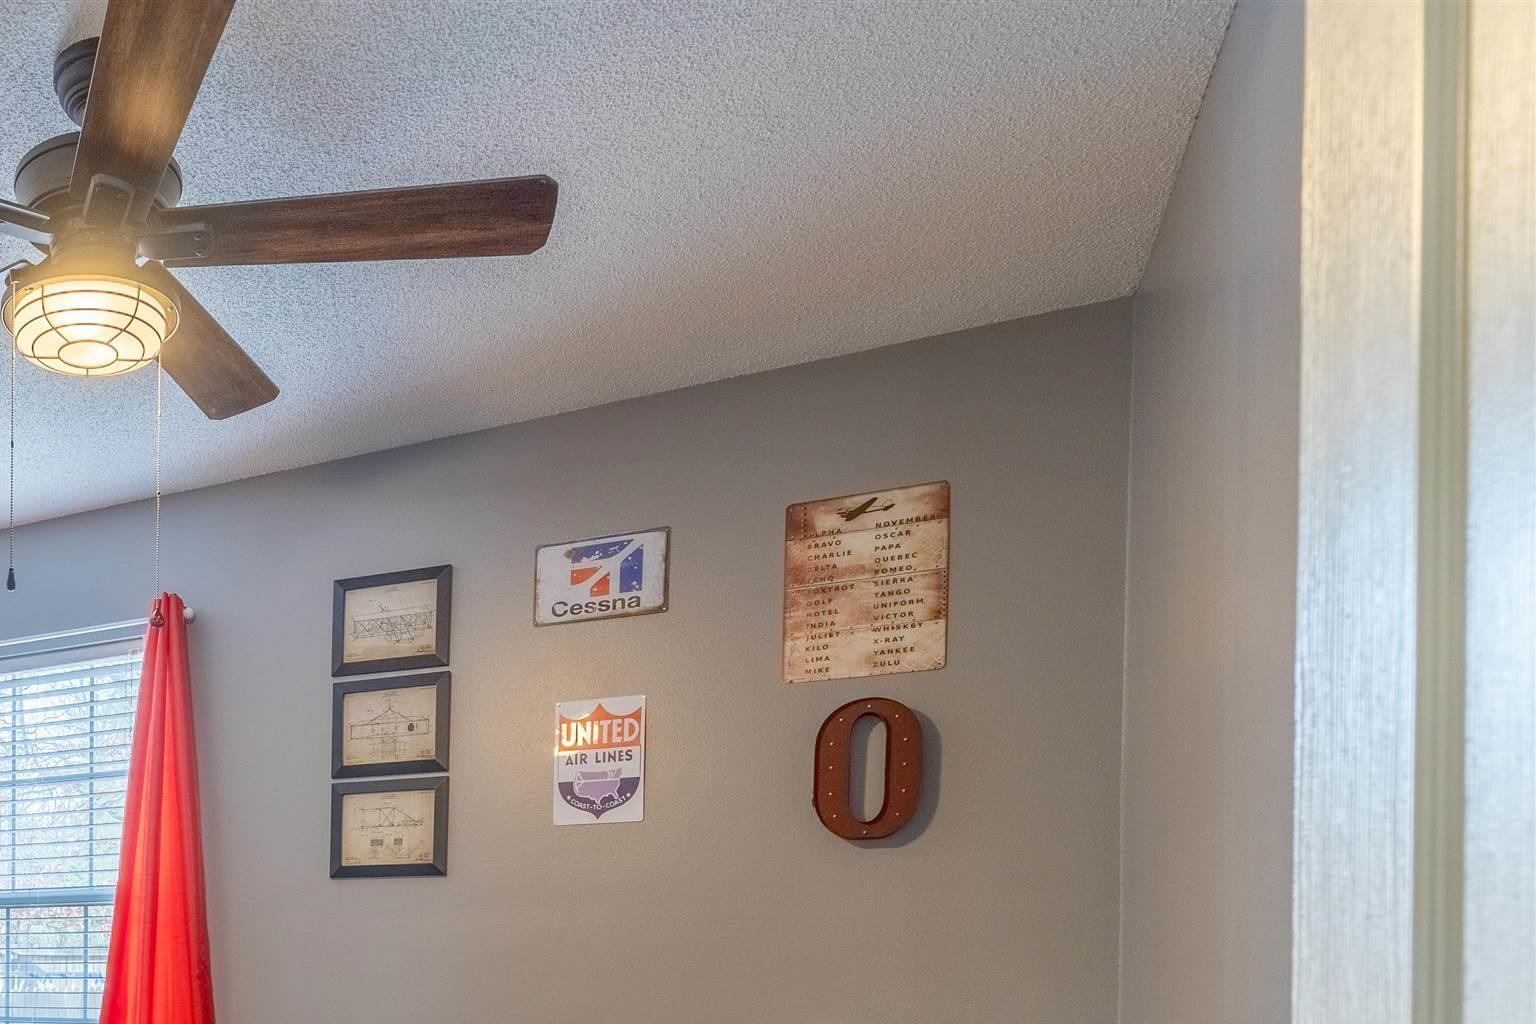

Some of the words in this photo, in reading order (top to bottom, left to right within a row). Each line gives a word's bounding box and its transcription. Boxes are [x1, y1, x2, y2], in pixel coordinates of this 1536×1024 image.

[875, 515, 937, 529] NOVEMBER
[874, 529, 911, 540] OSCAR
[807, 539, 842, 550] BRAVO
[874, 543, 901, 552] PAPA
[807, 550, 853, 562] CHARLIE
[874, 551, 918, 564] QUEBEC
[807, 563, 838, 573] DELTA
[874, 565, 912, 575] ROMEO
[873, 576, 913, 587] SIERRA
[873, 588, 911, 598] TANGO
[551, 594, 641, 618] Cessna
[806, 598, 833, 607] GOLF
[873, 598, 924, 610] UNIFORM
[806, 609, 840, 617] HOTEL
[873, 611, 914, 621] VICTOR
[806, 621, 836, 629] INDIA
[872, 622, 923, 632] WHISKEY
[805, 631, 840, 641] JULIET
[873, 635, 905, 644] X-RAY
[805, 644, 829, 652] KILO
[873, 646, 915, 656] YANKEE
[805, 656, 830, 664] LIMA
[872, 659, 900, 668] ZULU
[561, 717, 639, 747] UNITED
[565, 752, 588, 766] AIR
[595, 749, 633, 764] LINES
